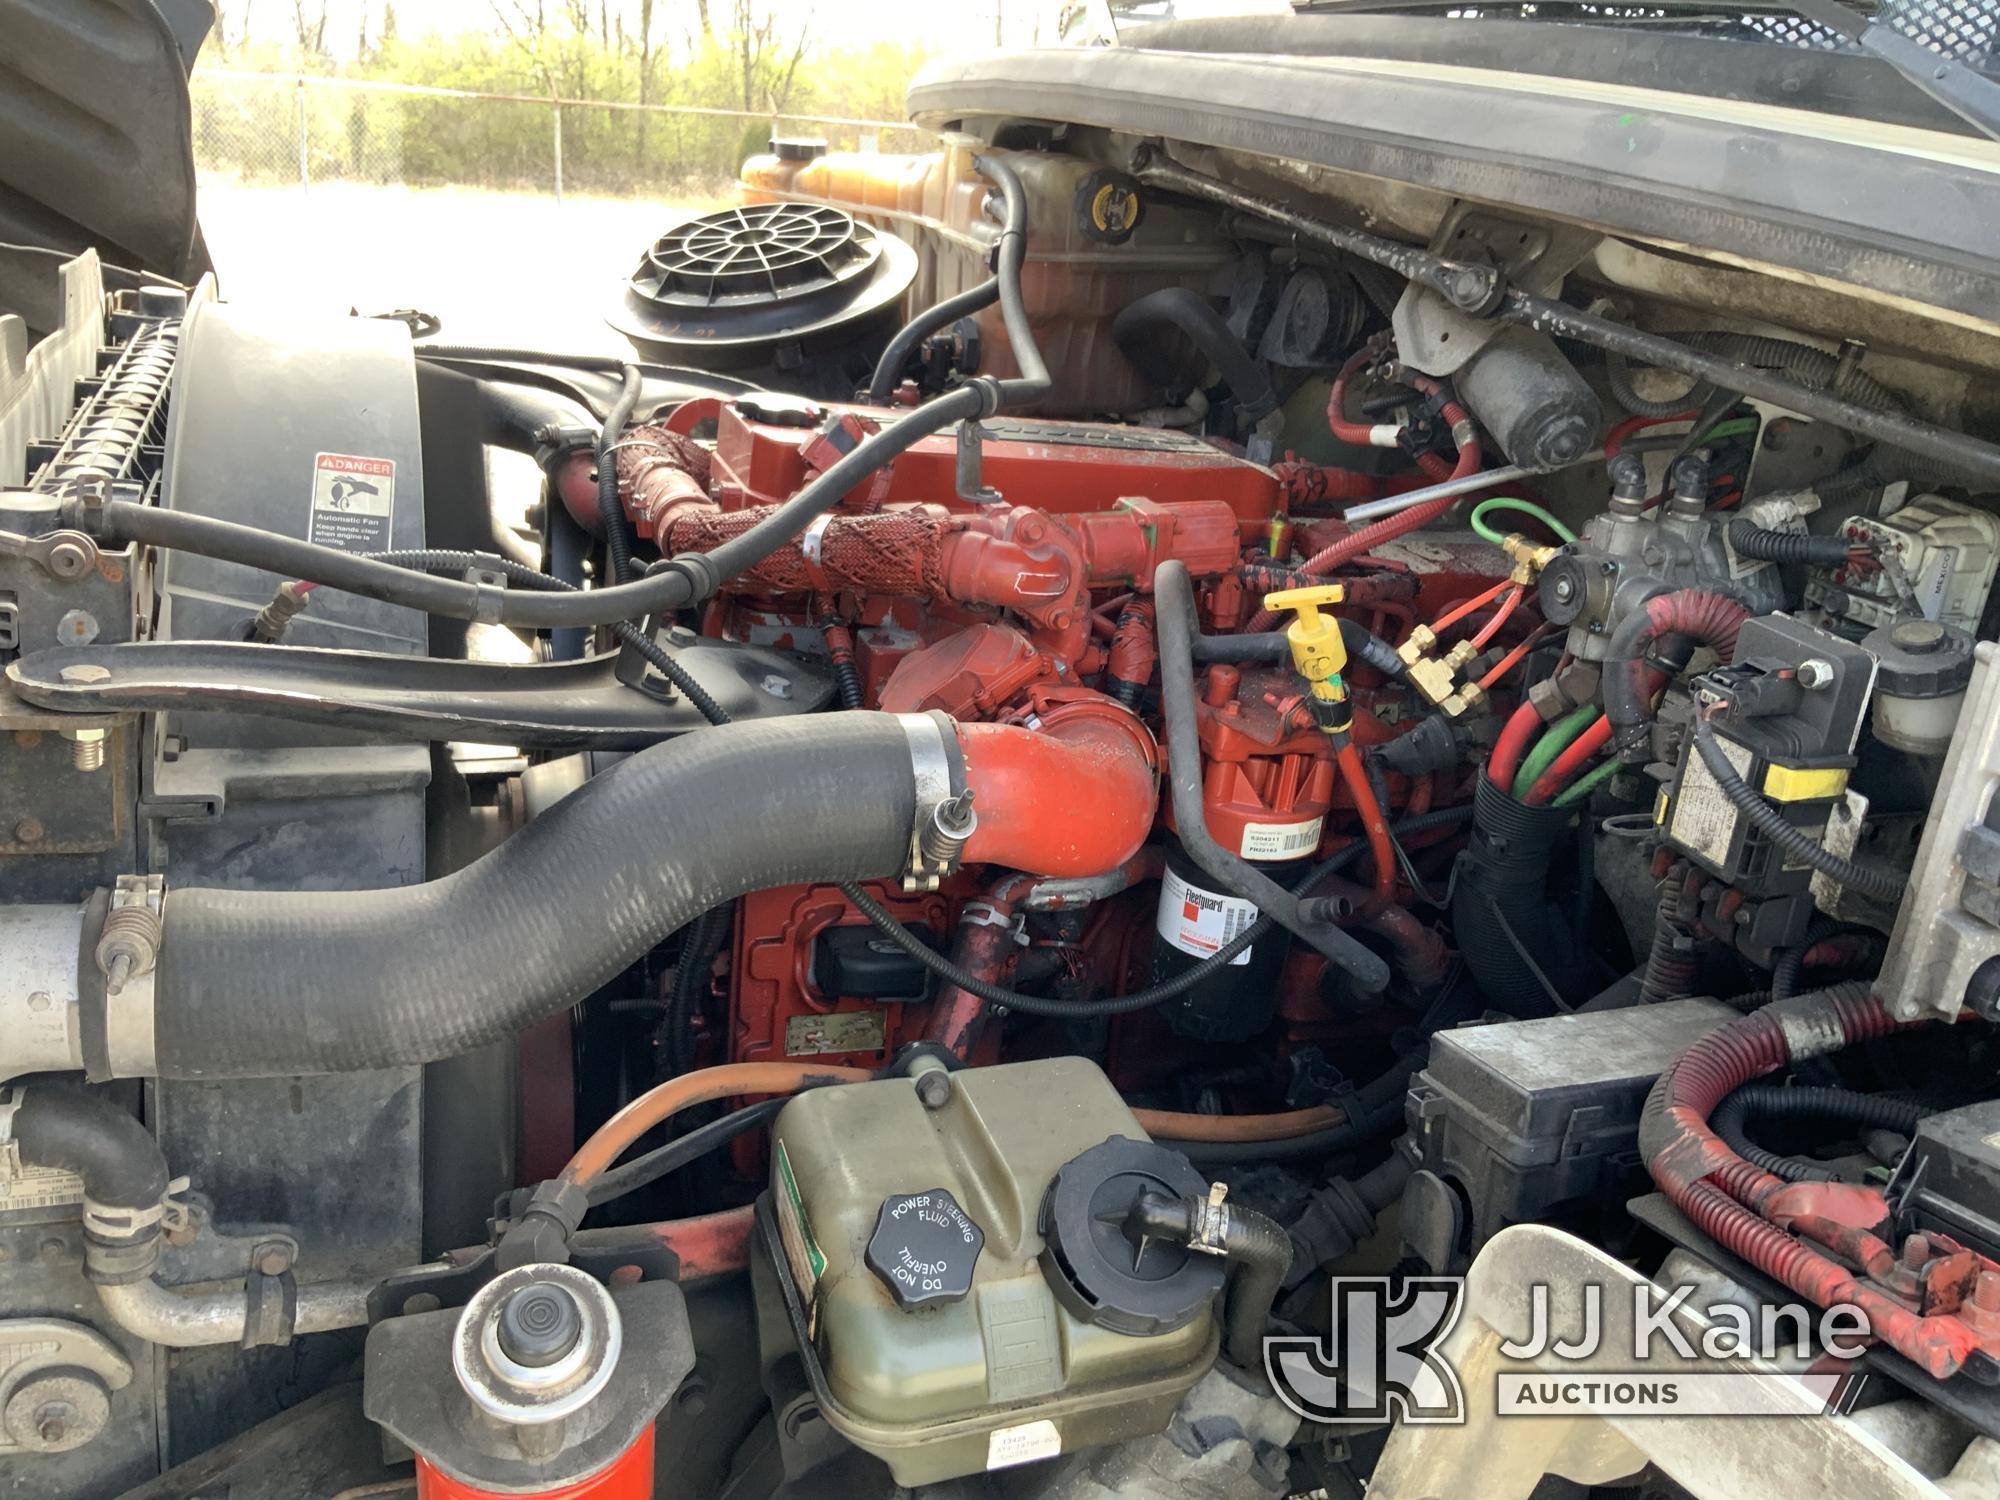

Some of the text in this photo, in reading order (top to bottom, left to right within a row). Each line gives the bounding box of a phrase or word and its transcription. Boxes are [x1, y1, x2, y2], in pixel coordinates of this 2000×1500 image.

[335, 460, 390, 474] DANGER
[316, 523, 335, 532] Keep
[317, 513, 379, 526] Automatic Fan
[337, 532, 362, 540] engine
[1935, 554, 1951, 594] MEXICO
[1185, 888, 1223, 912] Fleetguard
[891, 1196, 974, 1242] POWER STEERING
[918, 1210, 950, 1228] FLUID
[898, 1246, 947, 1275] OVERFILL
[891, 1266, 942, 1290] DO NOT
